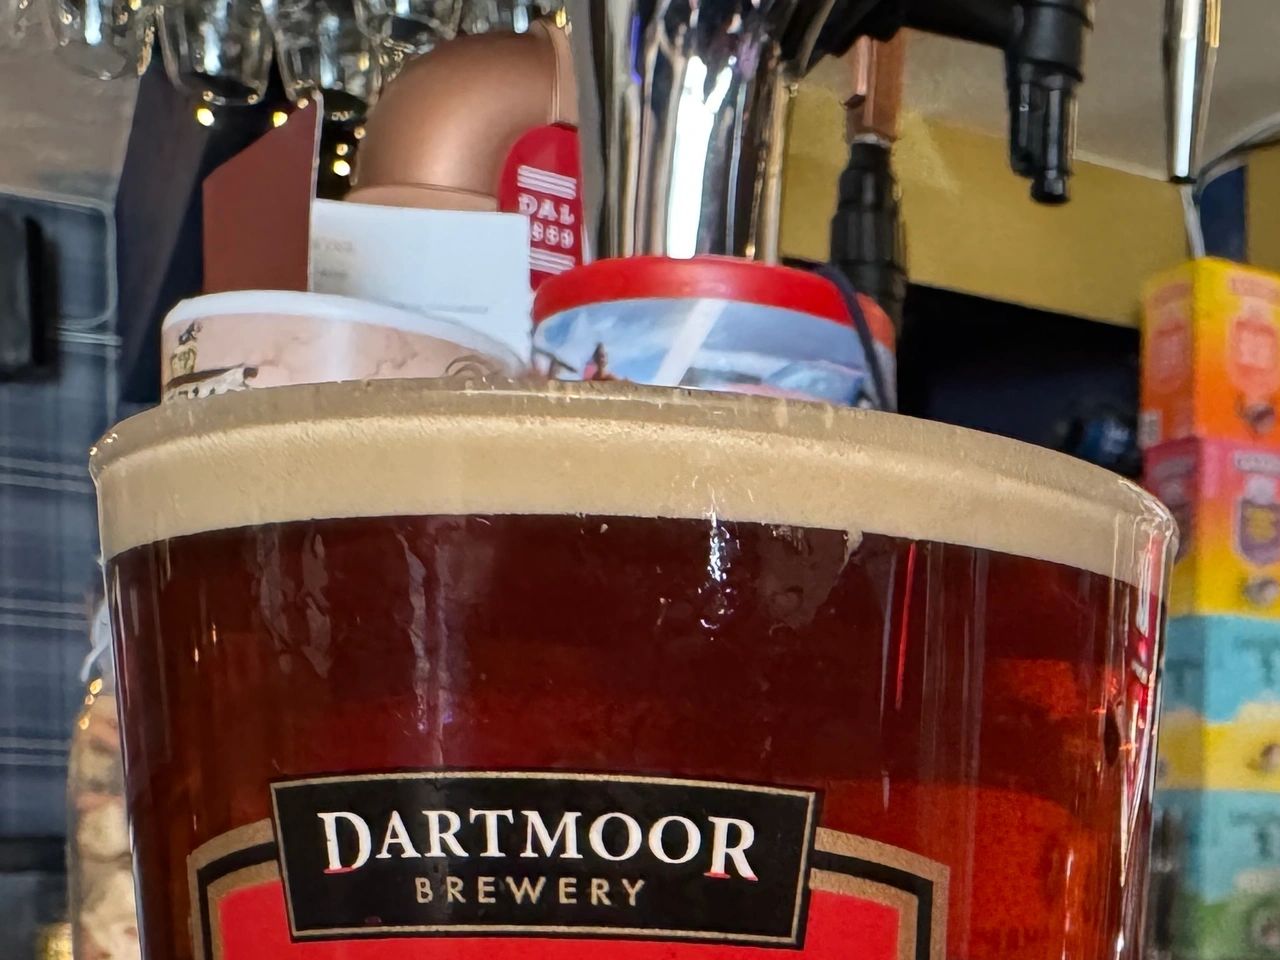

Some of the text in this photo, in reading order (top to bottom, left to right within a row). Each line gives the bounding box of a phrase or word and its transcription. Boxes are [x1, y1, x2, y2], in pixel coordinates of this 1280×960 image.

[517, 193, 575, 226] DAL
[316, 808, 759, 881] DARTMOOR
[414, 875, 646, 907] BREWERY
